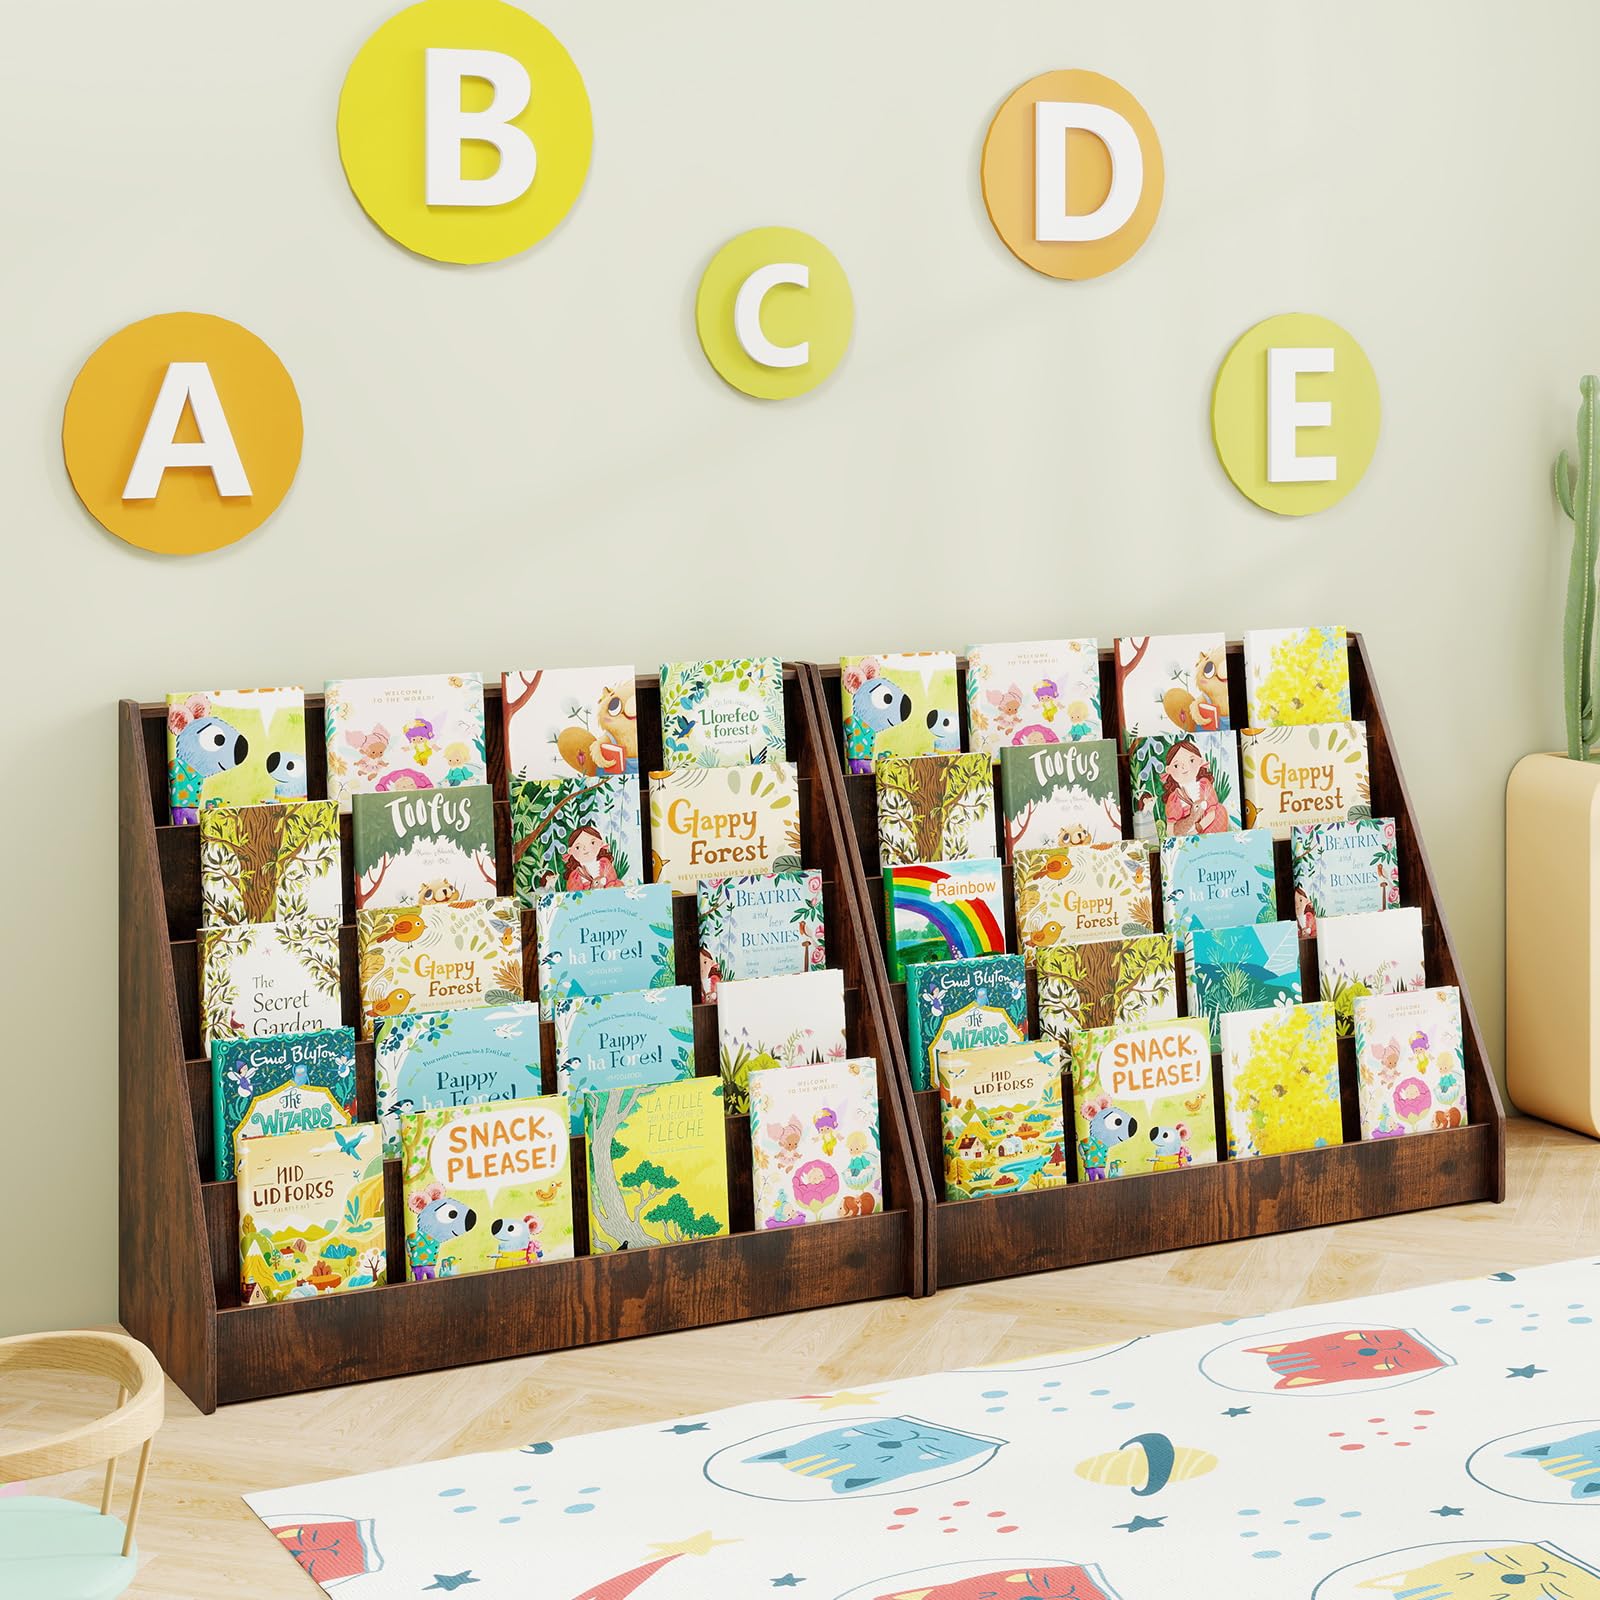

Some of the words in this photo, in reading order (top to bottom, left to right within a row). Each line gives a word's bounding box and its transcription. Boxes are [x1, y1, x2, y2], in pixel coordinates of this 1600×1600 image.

[426, 47, 538, 208] B
[1034, 101, 1144, 243] D
[734, 262, 810, 368] C
[1267, 347, 1338, 483] E
[122, 361, 253, 501] A
[384, 689, 423, 697] WELCOME
[714, 724, 750, 738] forest
[1028, 746, 1100, 787] Toofus
[1279, 787, 1344, 813] Forest
[384, 792, 471, 839] Toofus
[689, 836, 769, 866] Forest
[1325, 834, 1379, 851] BEATRIX
[936, 881, 996, 897] Rainbow
[1330, 872, 1379, 887] BUNNIES
[736, 887, 801, 907] BEATRIX
[1076, 912, 1120, 930] Forest
[742, 930, 800, 947] BUNNIES
[252, 974, 274, 989] The
[429, 977, 482, 998] Forest
[973, 968, 1011, 988] Blyton
[253, 989, 310, 1013] Secret
[253, 1011, 323, 1036] Garden
[291, 1041, 338, 1064] Blyton
[1113, 1034, 1198, 1068] SNACK,
[1112, 1060, 1201, 1094] PLEASE!
[647, 1097, 662, 1113] LA
[449, 1115, 553, 1153] SNACK,
[447, 1144, 557, 1183] PLEASE!
